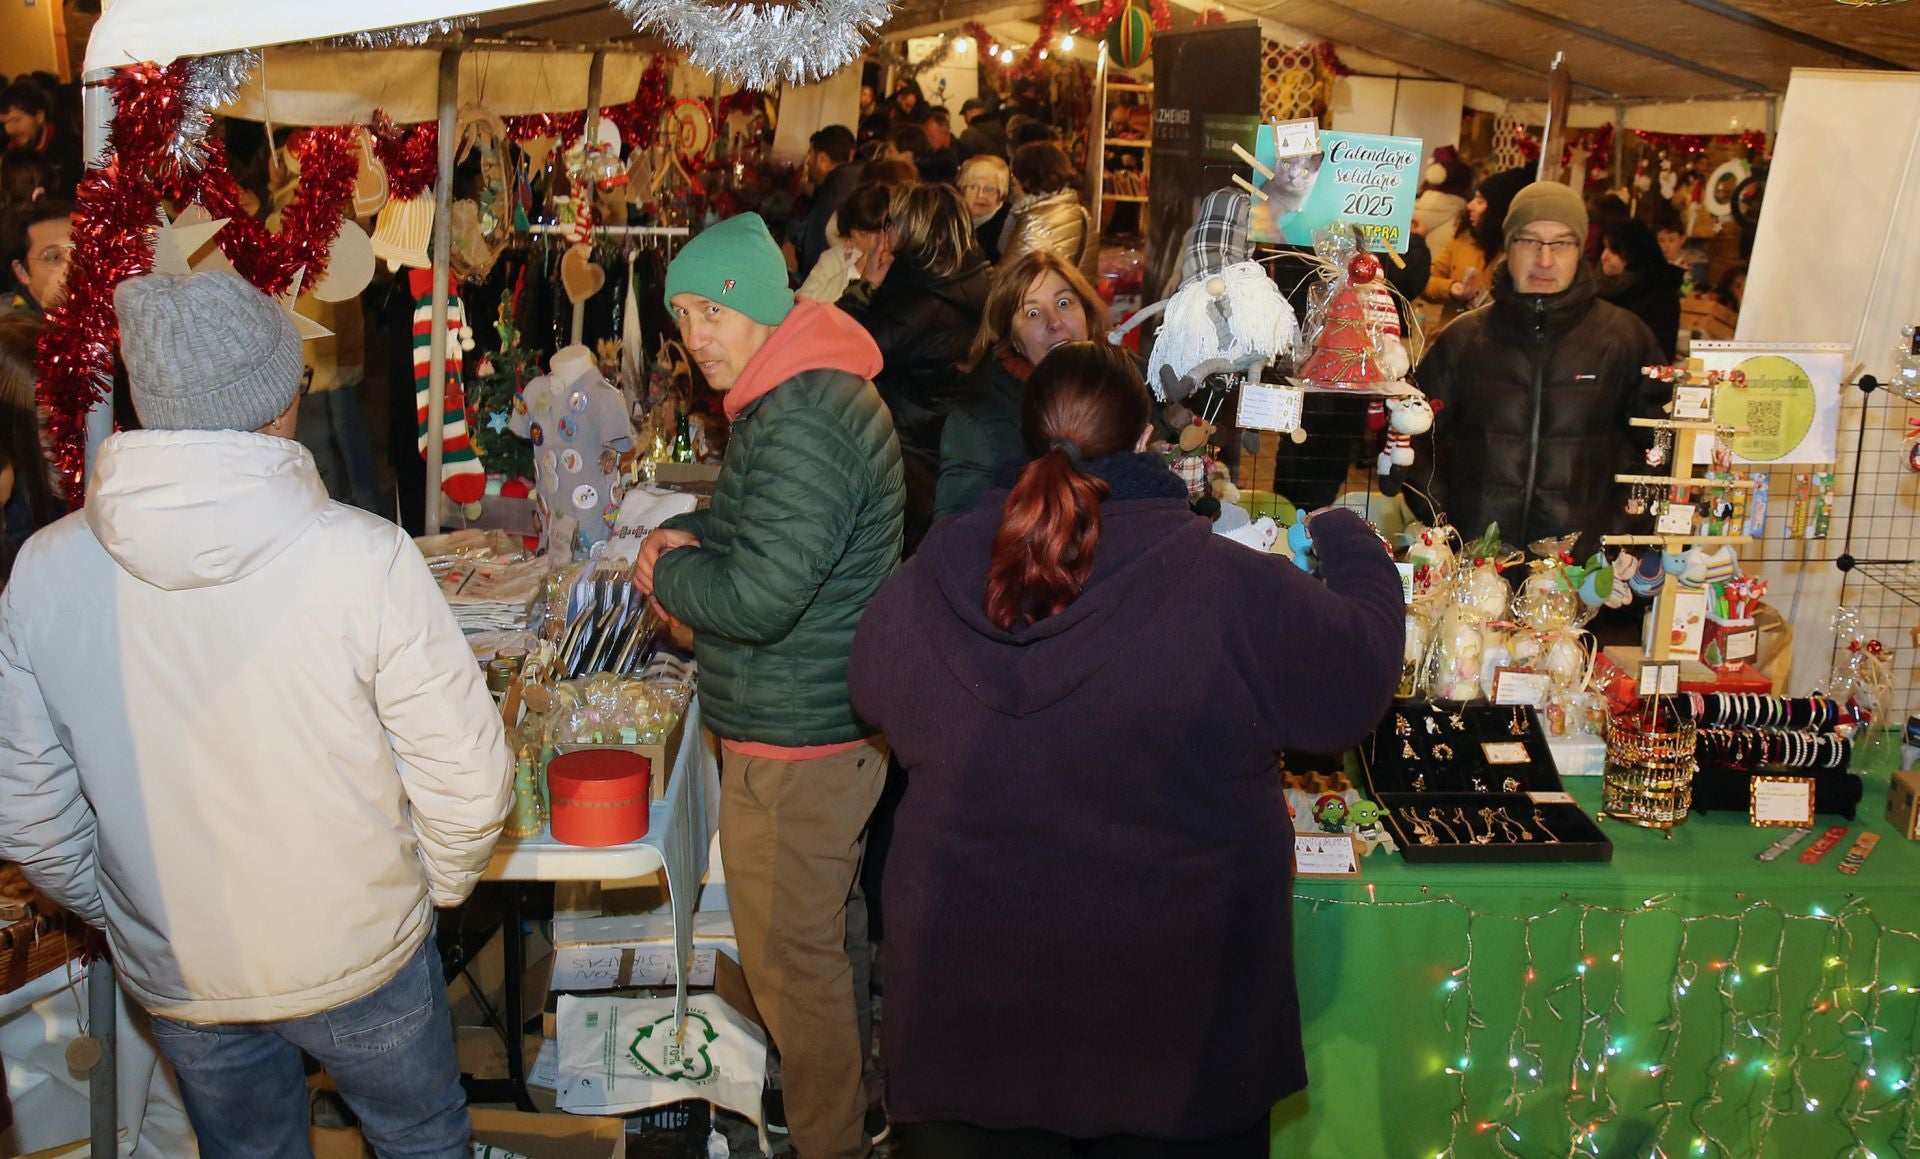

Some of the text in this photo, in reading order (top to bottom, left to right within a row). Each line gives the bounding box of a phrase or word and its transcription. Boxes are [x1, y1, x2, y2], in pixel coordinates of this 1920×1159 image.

[1328, 138, 1416, 170] Calendario
[1336, 167, 1402, 192] solidario
[1343, 194, 1395, 217] 2025
